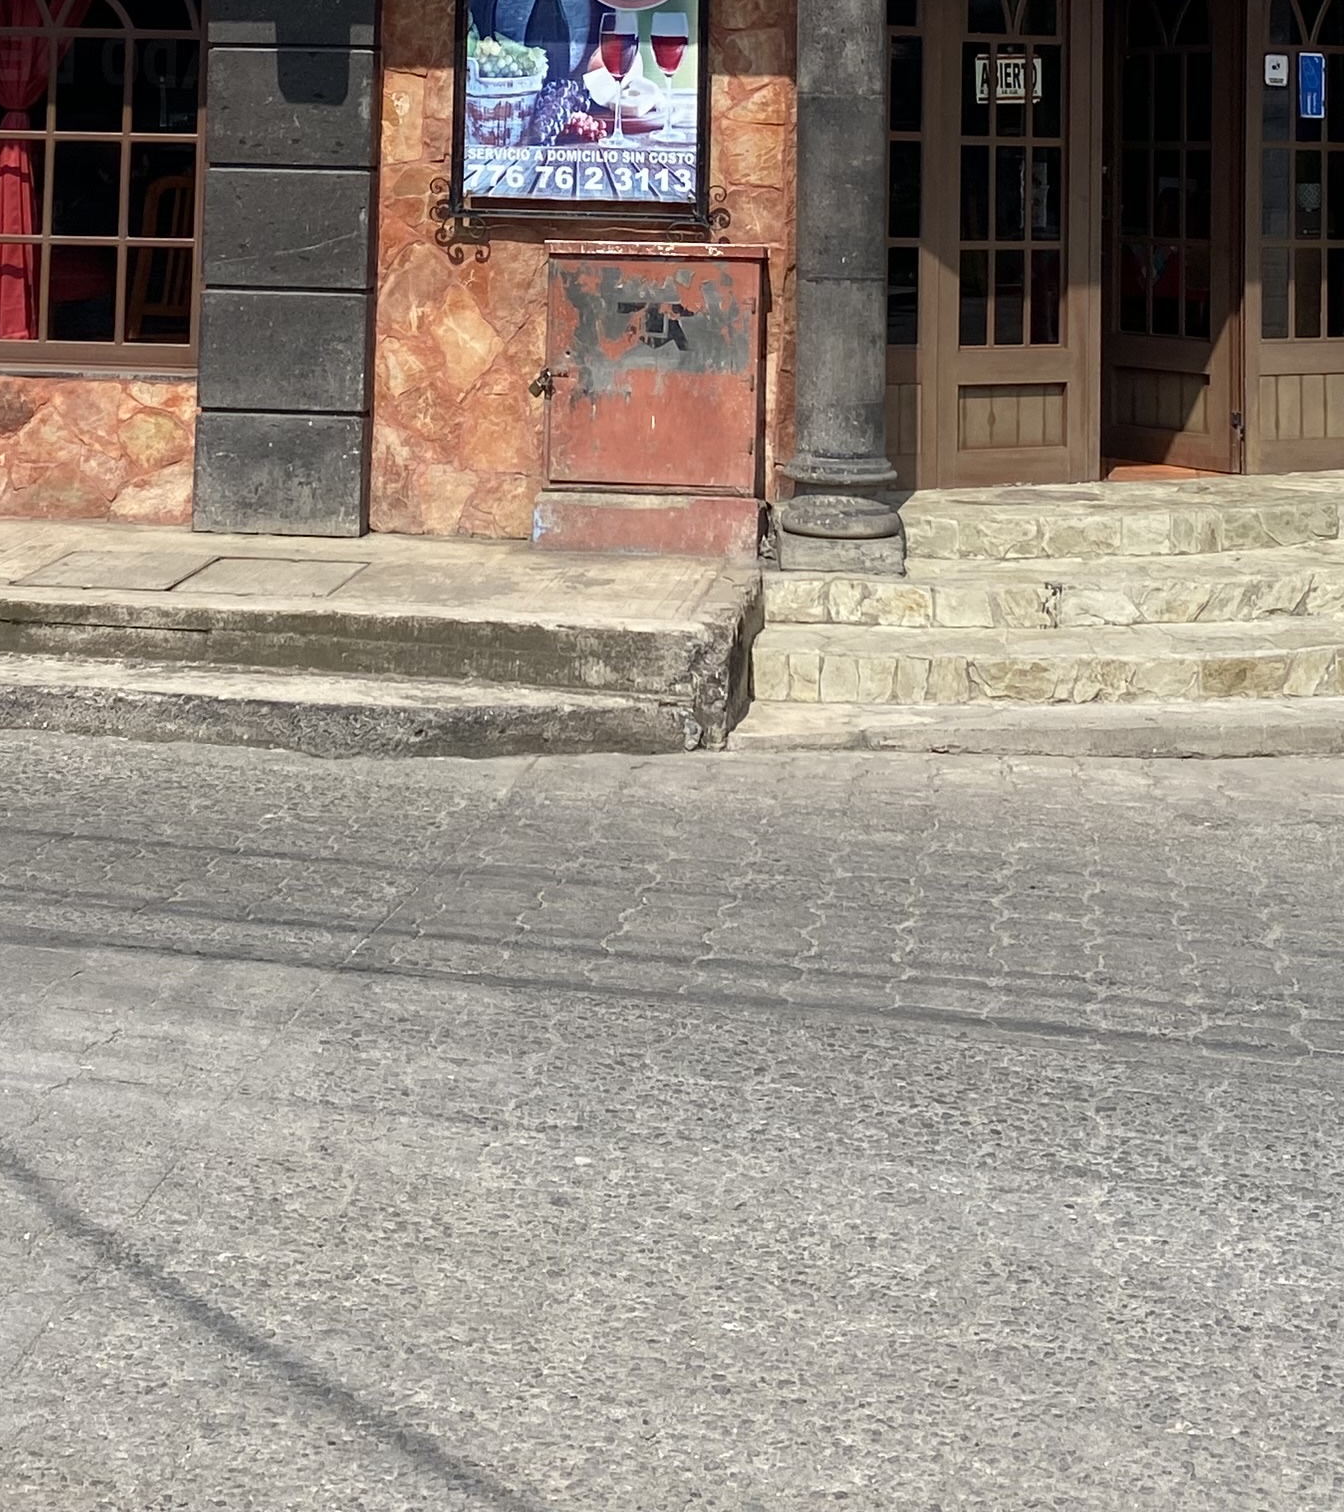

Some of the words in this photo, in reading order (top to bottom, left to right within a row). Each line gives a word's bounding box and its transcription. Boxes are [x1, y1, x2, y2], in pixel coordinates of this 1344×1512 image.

[468, 148, 530, 161] SERVICIO
[535, 149, 545, 161] A
[547, 149, 618, 163] DOMICILIO
[622, 151, 645, 163] SIN
[649, 152, 695, 165] COSTO
[467, 165, 525, 188] 776
[535, 166, 574, 190] 76
[584, 167, 604, 190] 2
[614, 168, 692, 192] 3113
